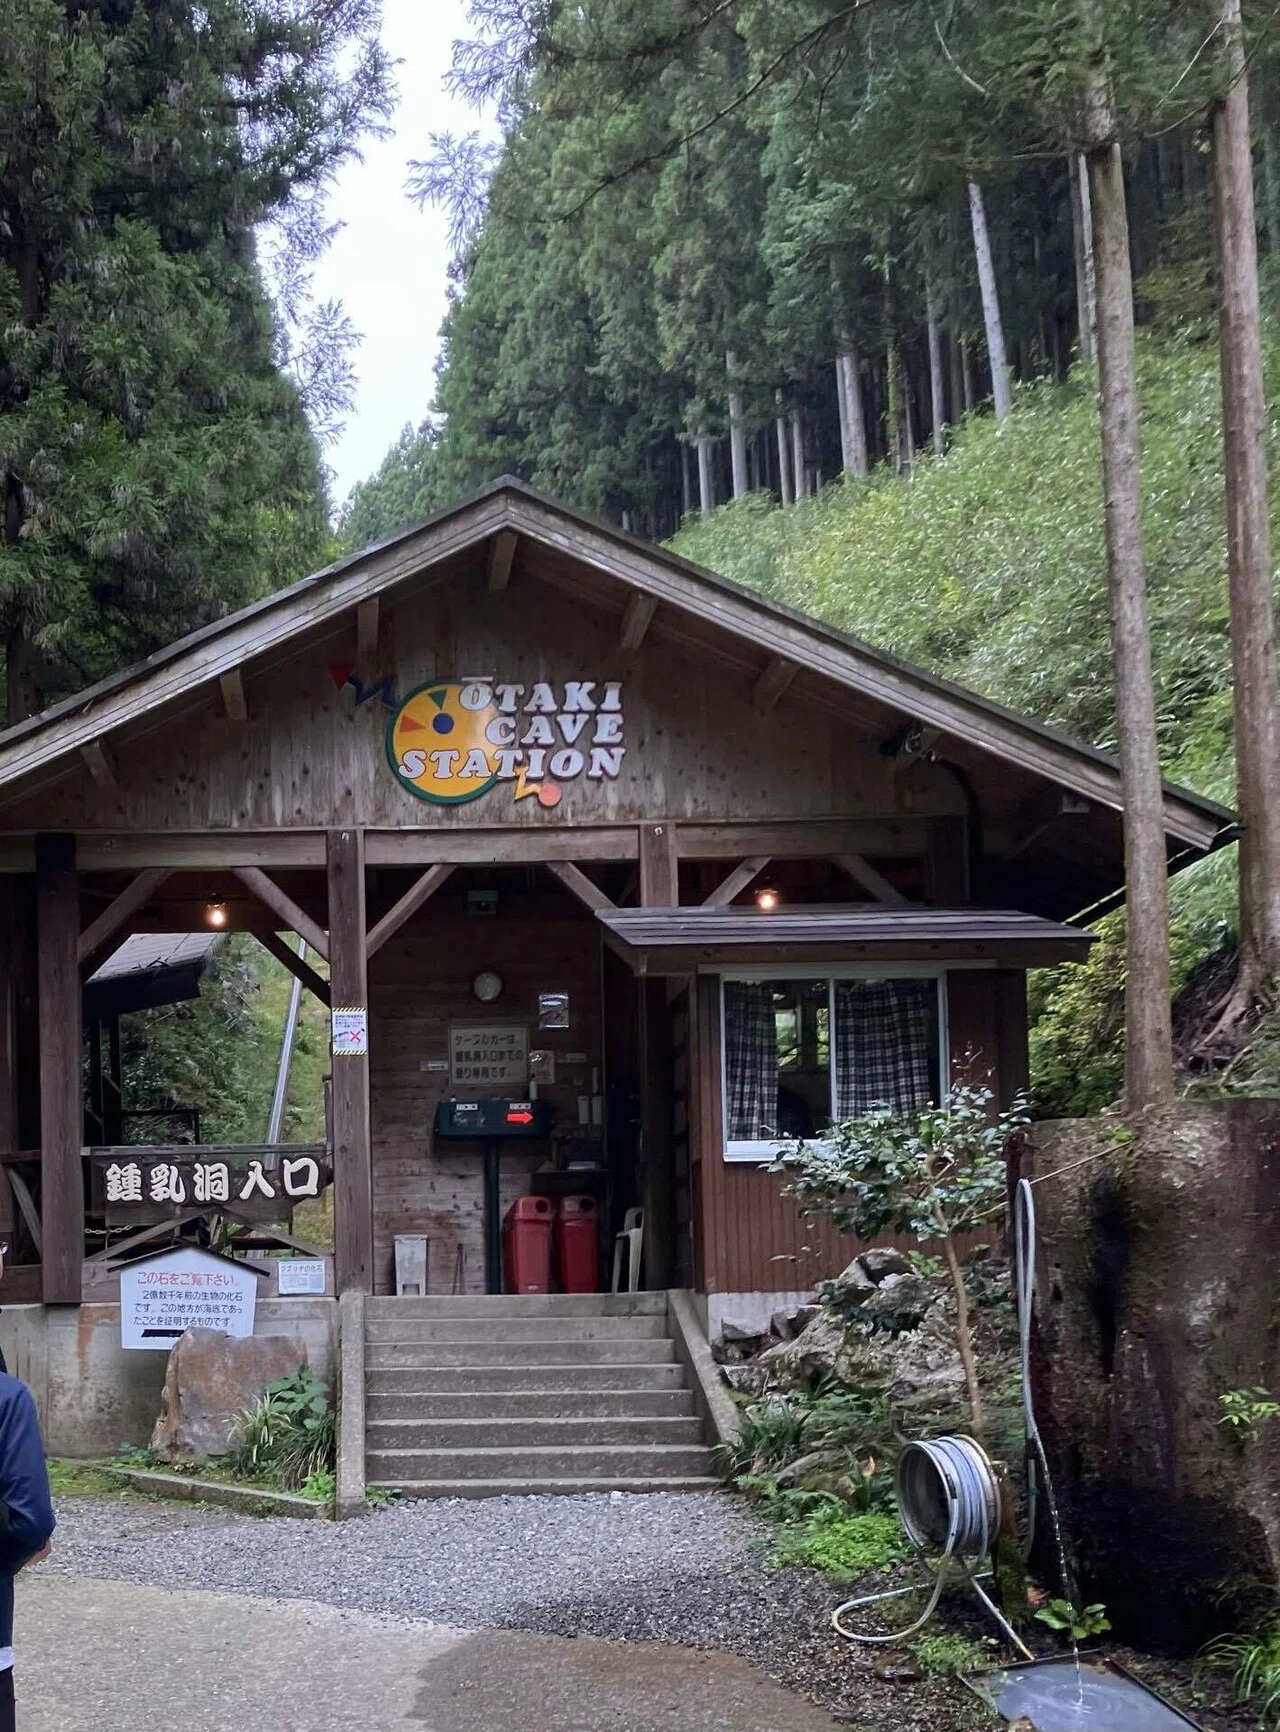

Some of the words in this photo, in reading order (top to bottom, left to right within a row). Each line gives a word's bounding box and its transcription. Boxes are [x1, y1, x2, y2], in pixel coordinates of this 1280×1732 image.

[459, 677, 623, 712] ŌTAKI
[485, 713, 624, 745] CAVE
[398, 748, 626, 780] STATION
[106, 1157, 319, 1203] 鍾乳洞入口
[137, 1272, 239, 1286] この石をご覧下さい。
[133, 1316, 235, 1328] たことを証明するものです。
